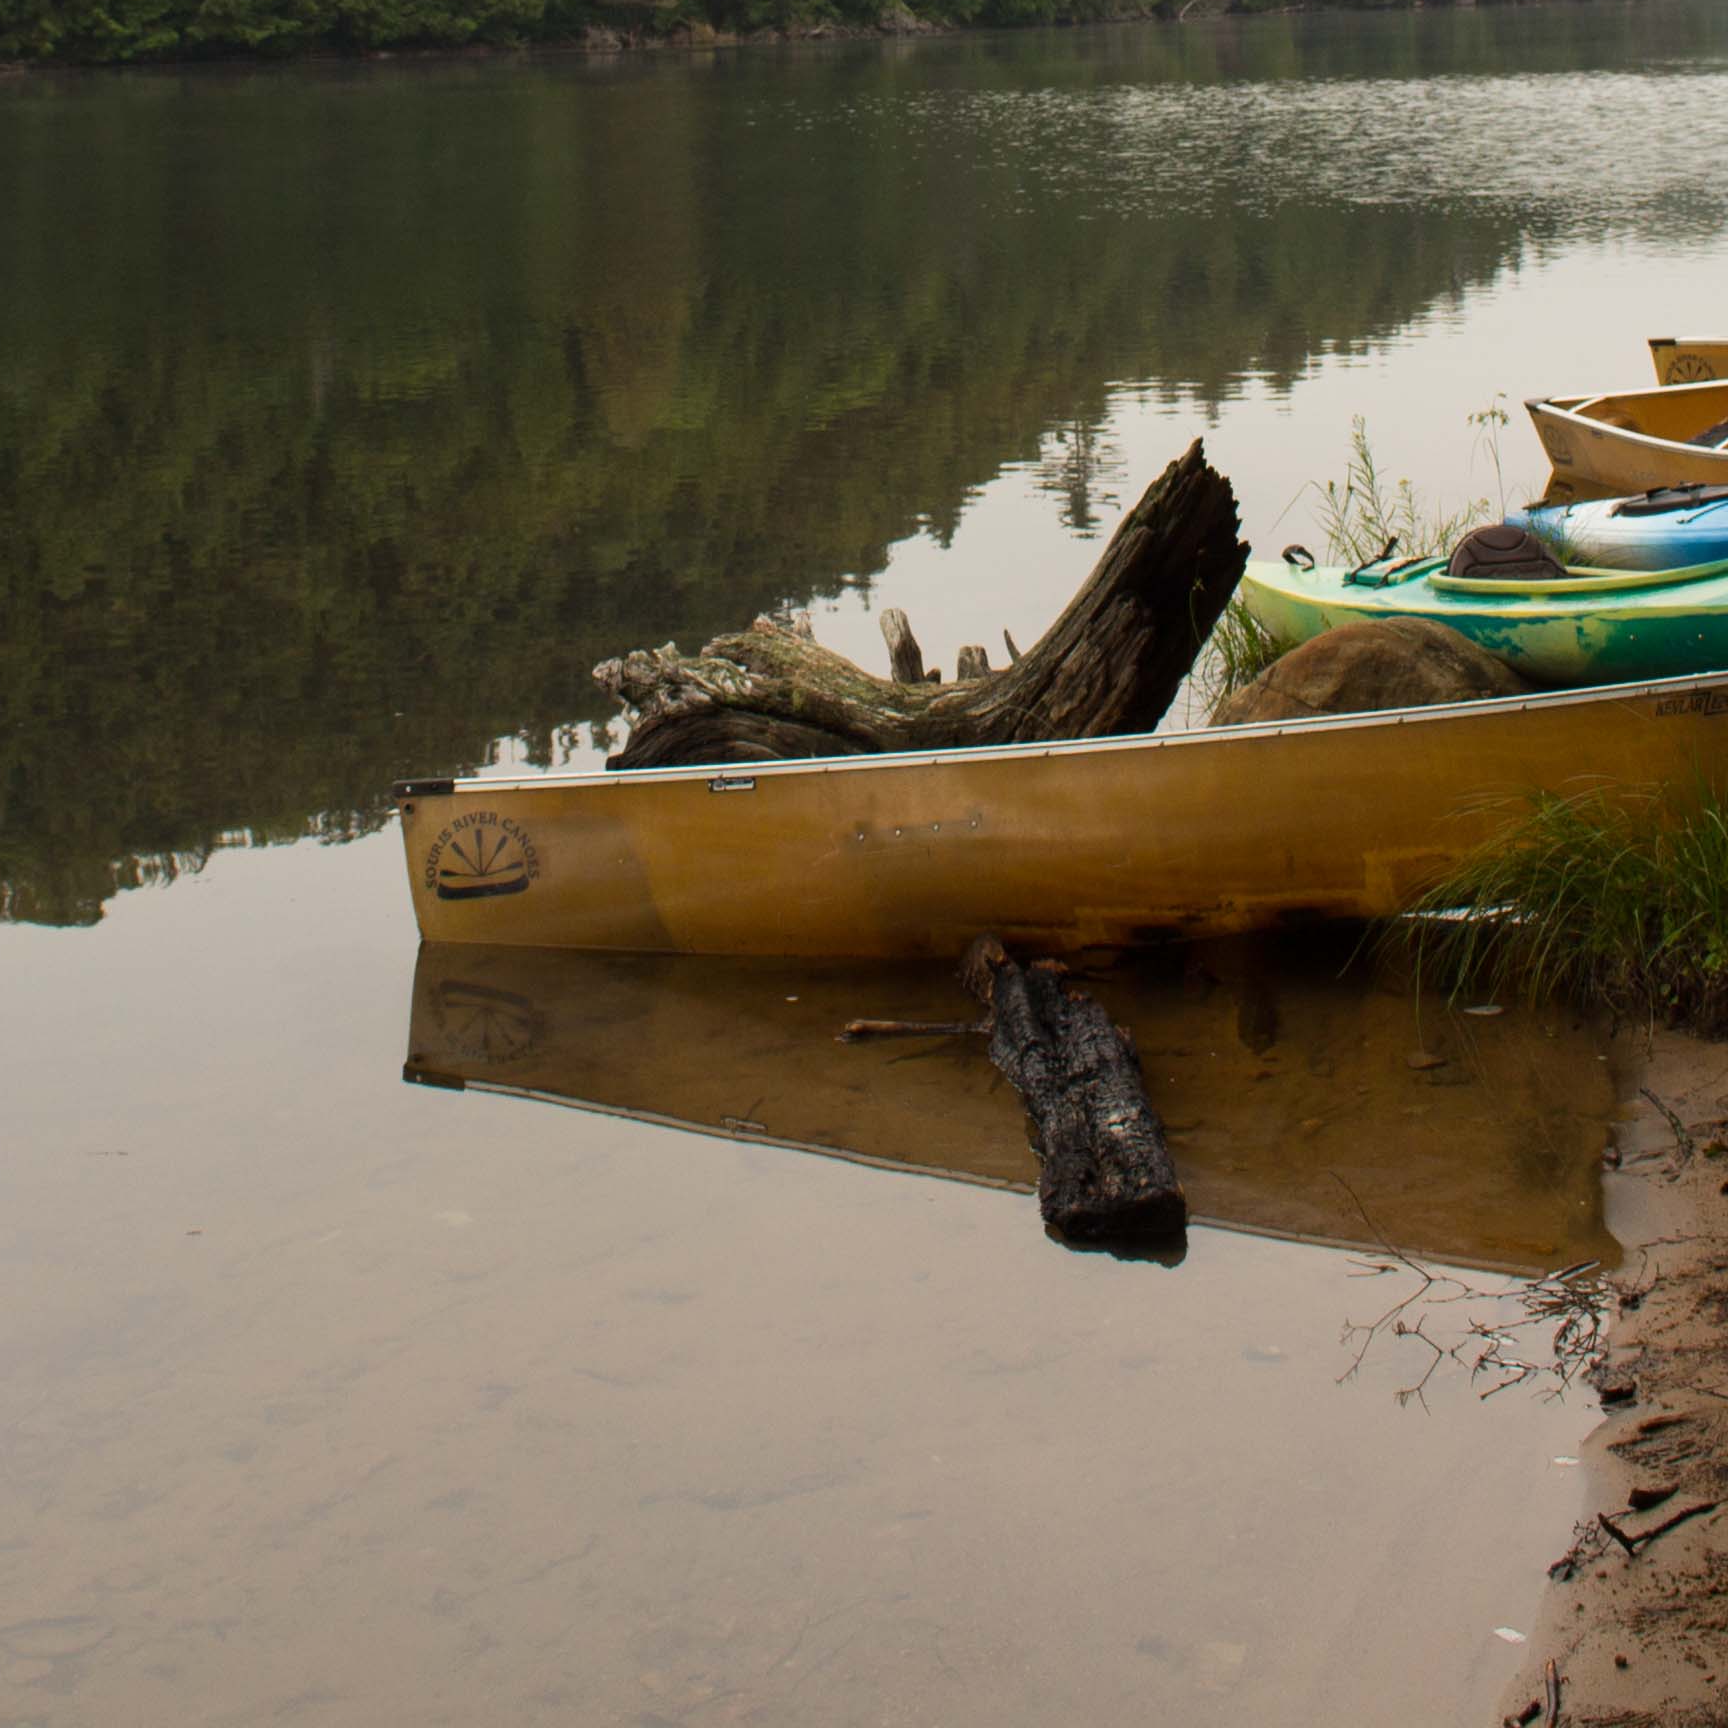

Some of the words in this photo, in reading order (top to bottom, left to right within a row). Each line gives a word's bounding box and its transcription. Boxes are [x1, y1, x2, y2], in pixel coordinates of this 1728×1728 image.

[425, 828, 452, 889] SOURIS
[452, 811, 498, 832] RIVER
[502, 818, 540, 881] CANOES
